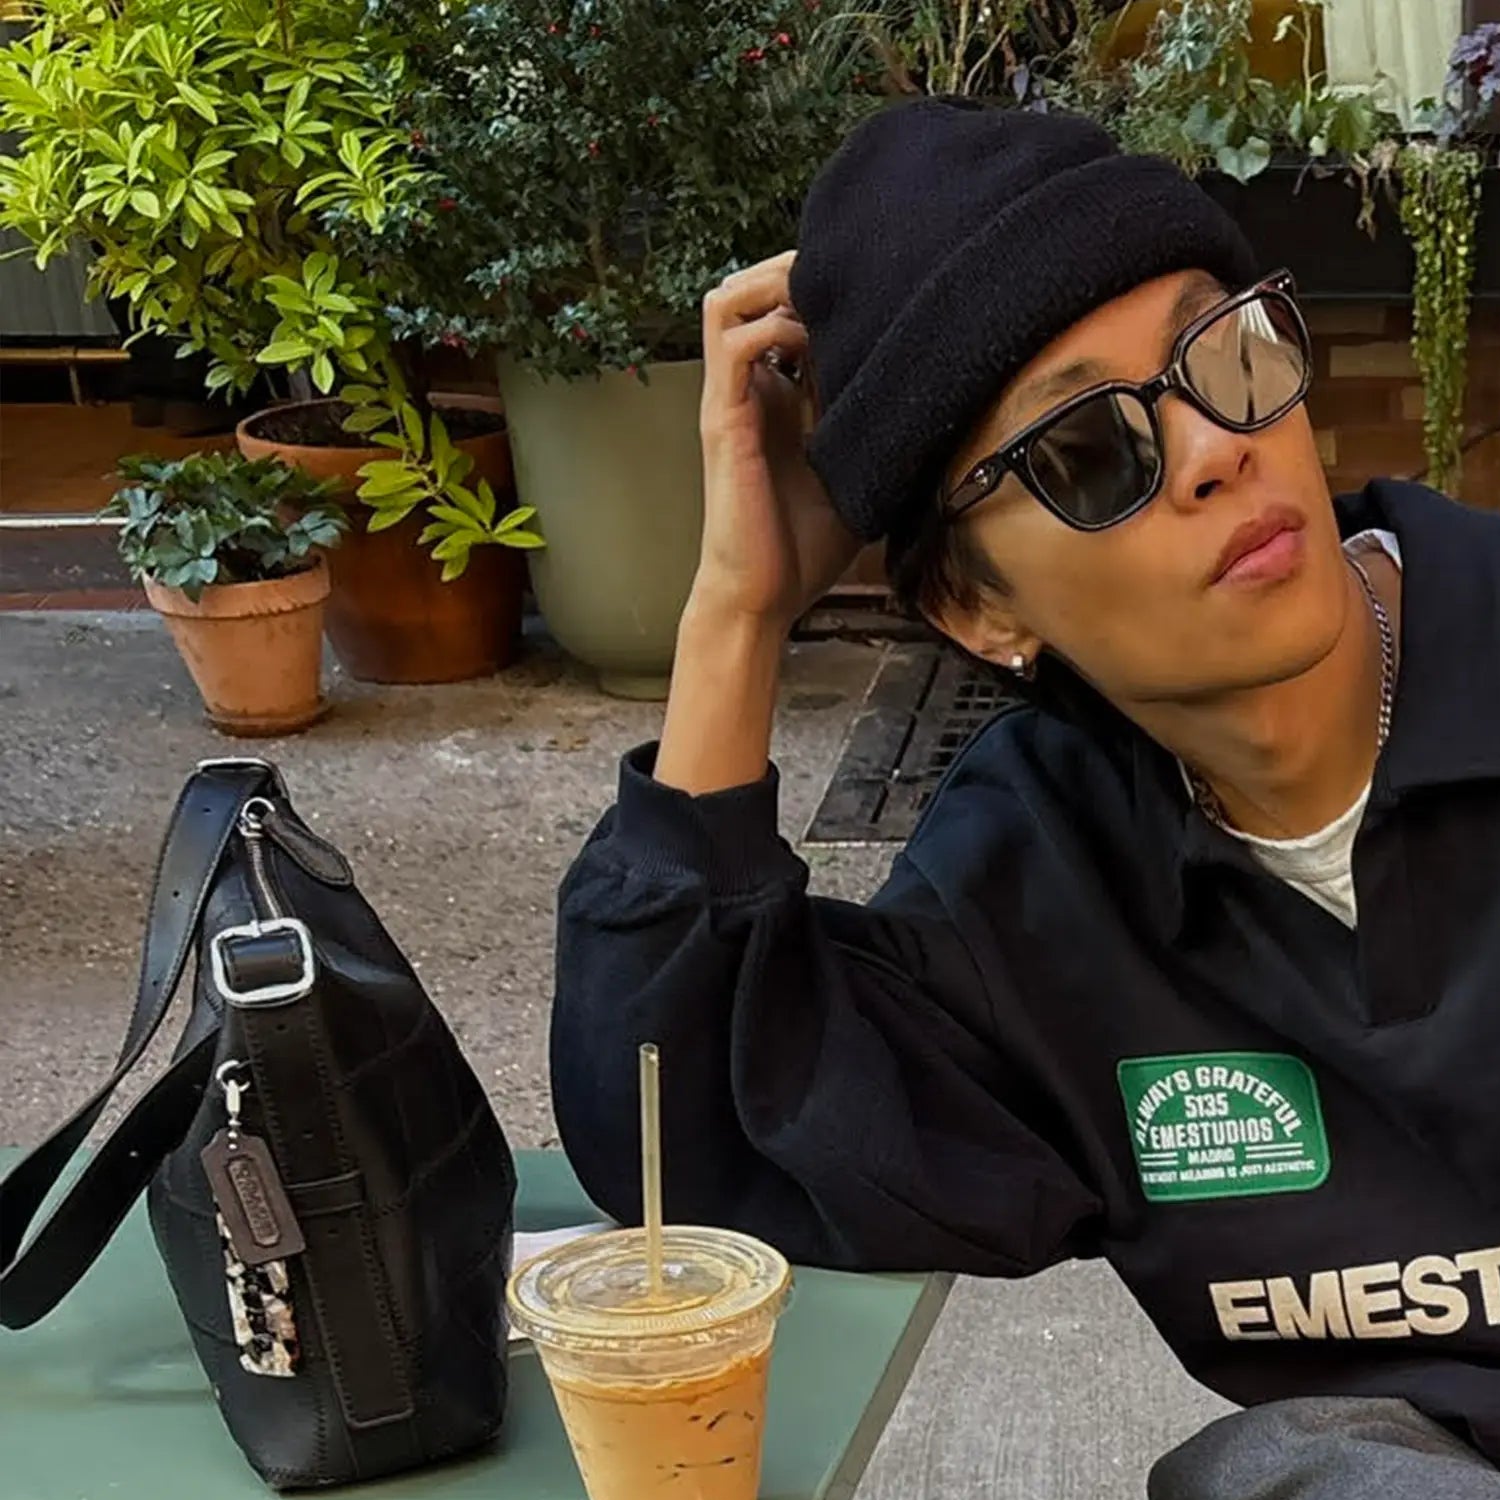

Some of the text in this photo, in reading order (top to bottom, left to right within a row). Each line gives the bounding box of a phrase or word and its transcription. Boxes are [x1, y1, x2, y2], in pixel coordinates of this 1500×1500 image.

[1184, 1092, 1229, 1118] 5135
[1195, 1066, 1302, 1138] GRATEFUL
[1150, 1117, 1274, 1150] EMESTUDIOS
